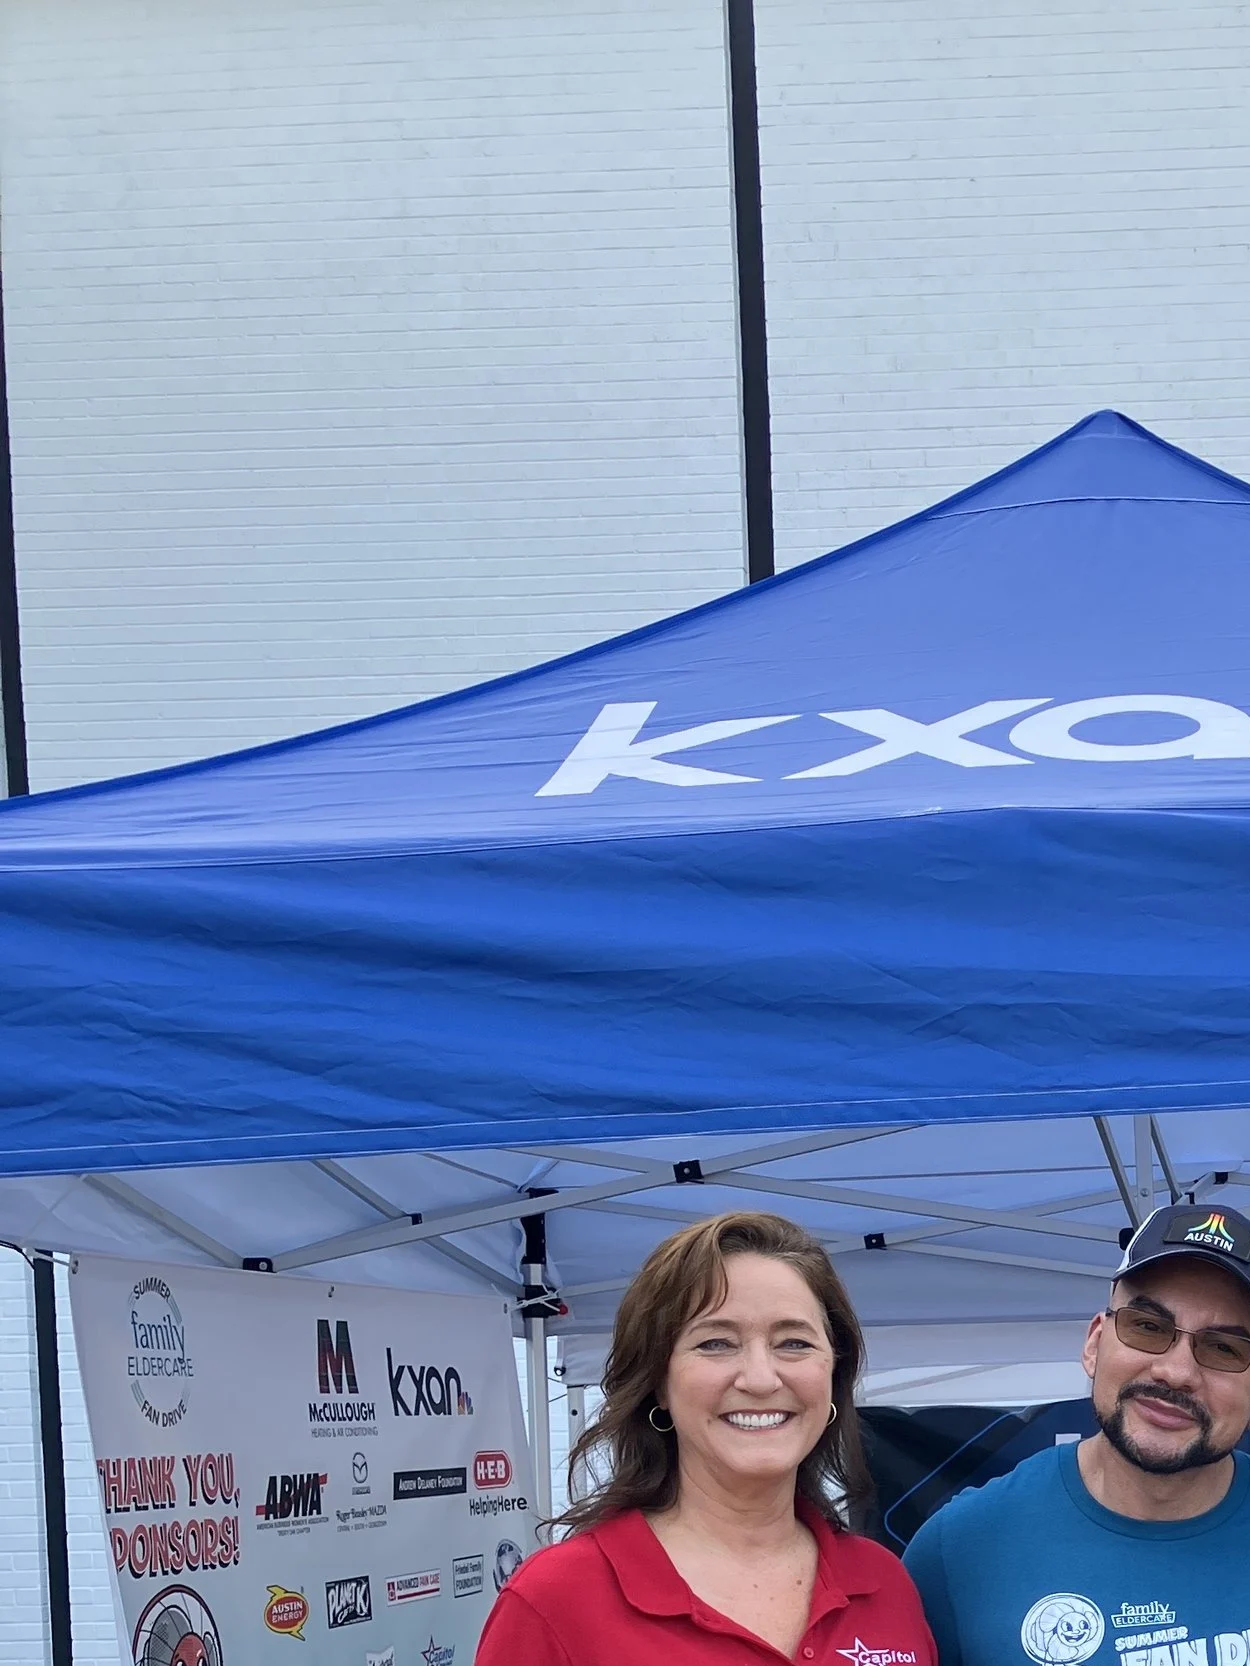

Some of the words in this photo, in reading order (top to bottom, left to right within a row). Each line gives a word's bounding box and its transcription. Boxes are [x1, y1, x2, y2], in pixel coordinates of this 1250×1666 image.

[1184, 1232, 1233, 1252] AUSTIN
[133, 1277, 171, 1302] SUMMER
[131, 1310, 184, 1364] family
[128, 1356, 194, 1377] ELDERCARE
[317, 1319, 359, 1394] M
[386, 1347, 462, 1416] kxan
[141, 1400, 160, 1425] FAN
[162, 1399, 187, 1427] DRIVE
[308, 1402, 376, 1422] McCULLOUGH
[182, 1453, 240, 1509] YOU,
[264, 1473, 322, 1520] ABWA
[110, 1516, 240, 1580] PONSORS!
[272, 1600, 303, 1615] AUSTIN
[272, 1610, 303, 1624] ENERGY
[1116, 1613, 1173, 1625] ELDERCARE
[1120, 1601, 1169, 1619] family
[1115, 1626, 1189, 1651] SUMMER
[858, 1650, 916, 1666] Capitol
